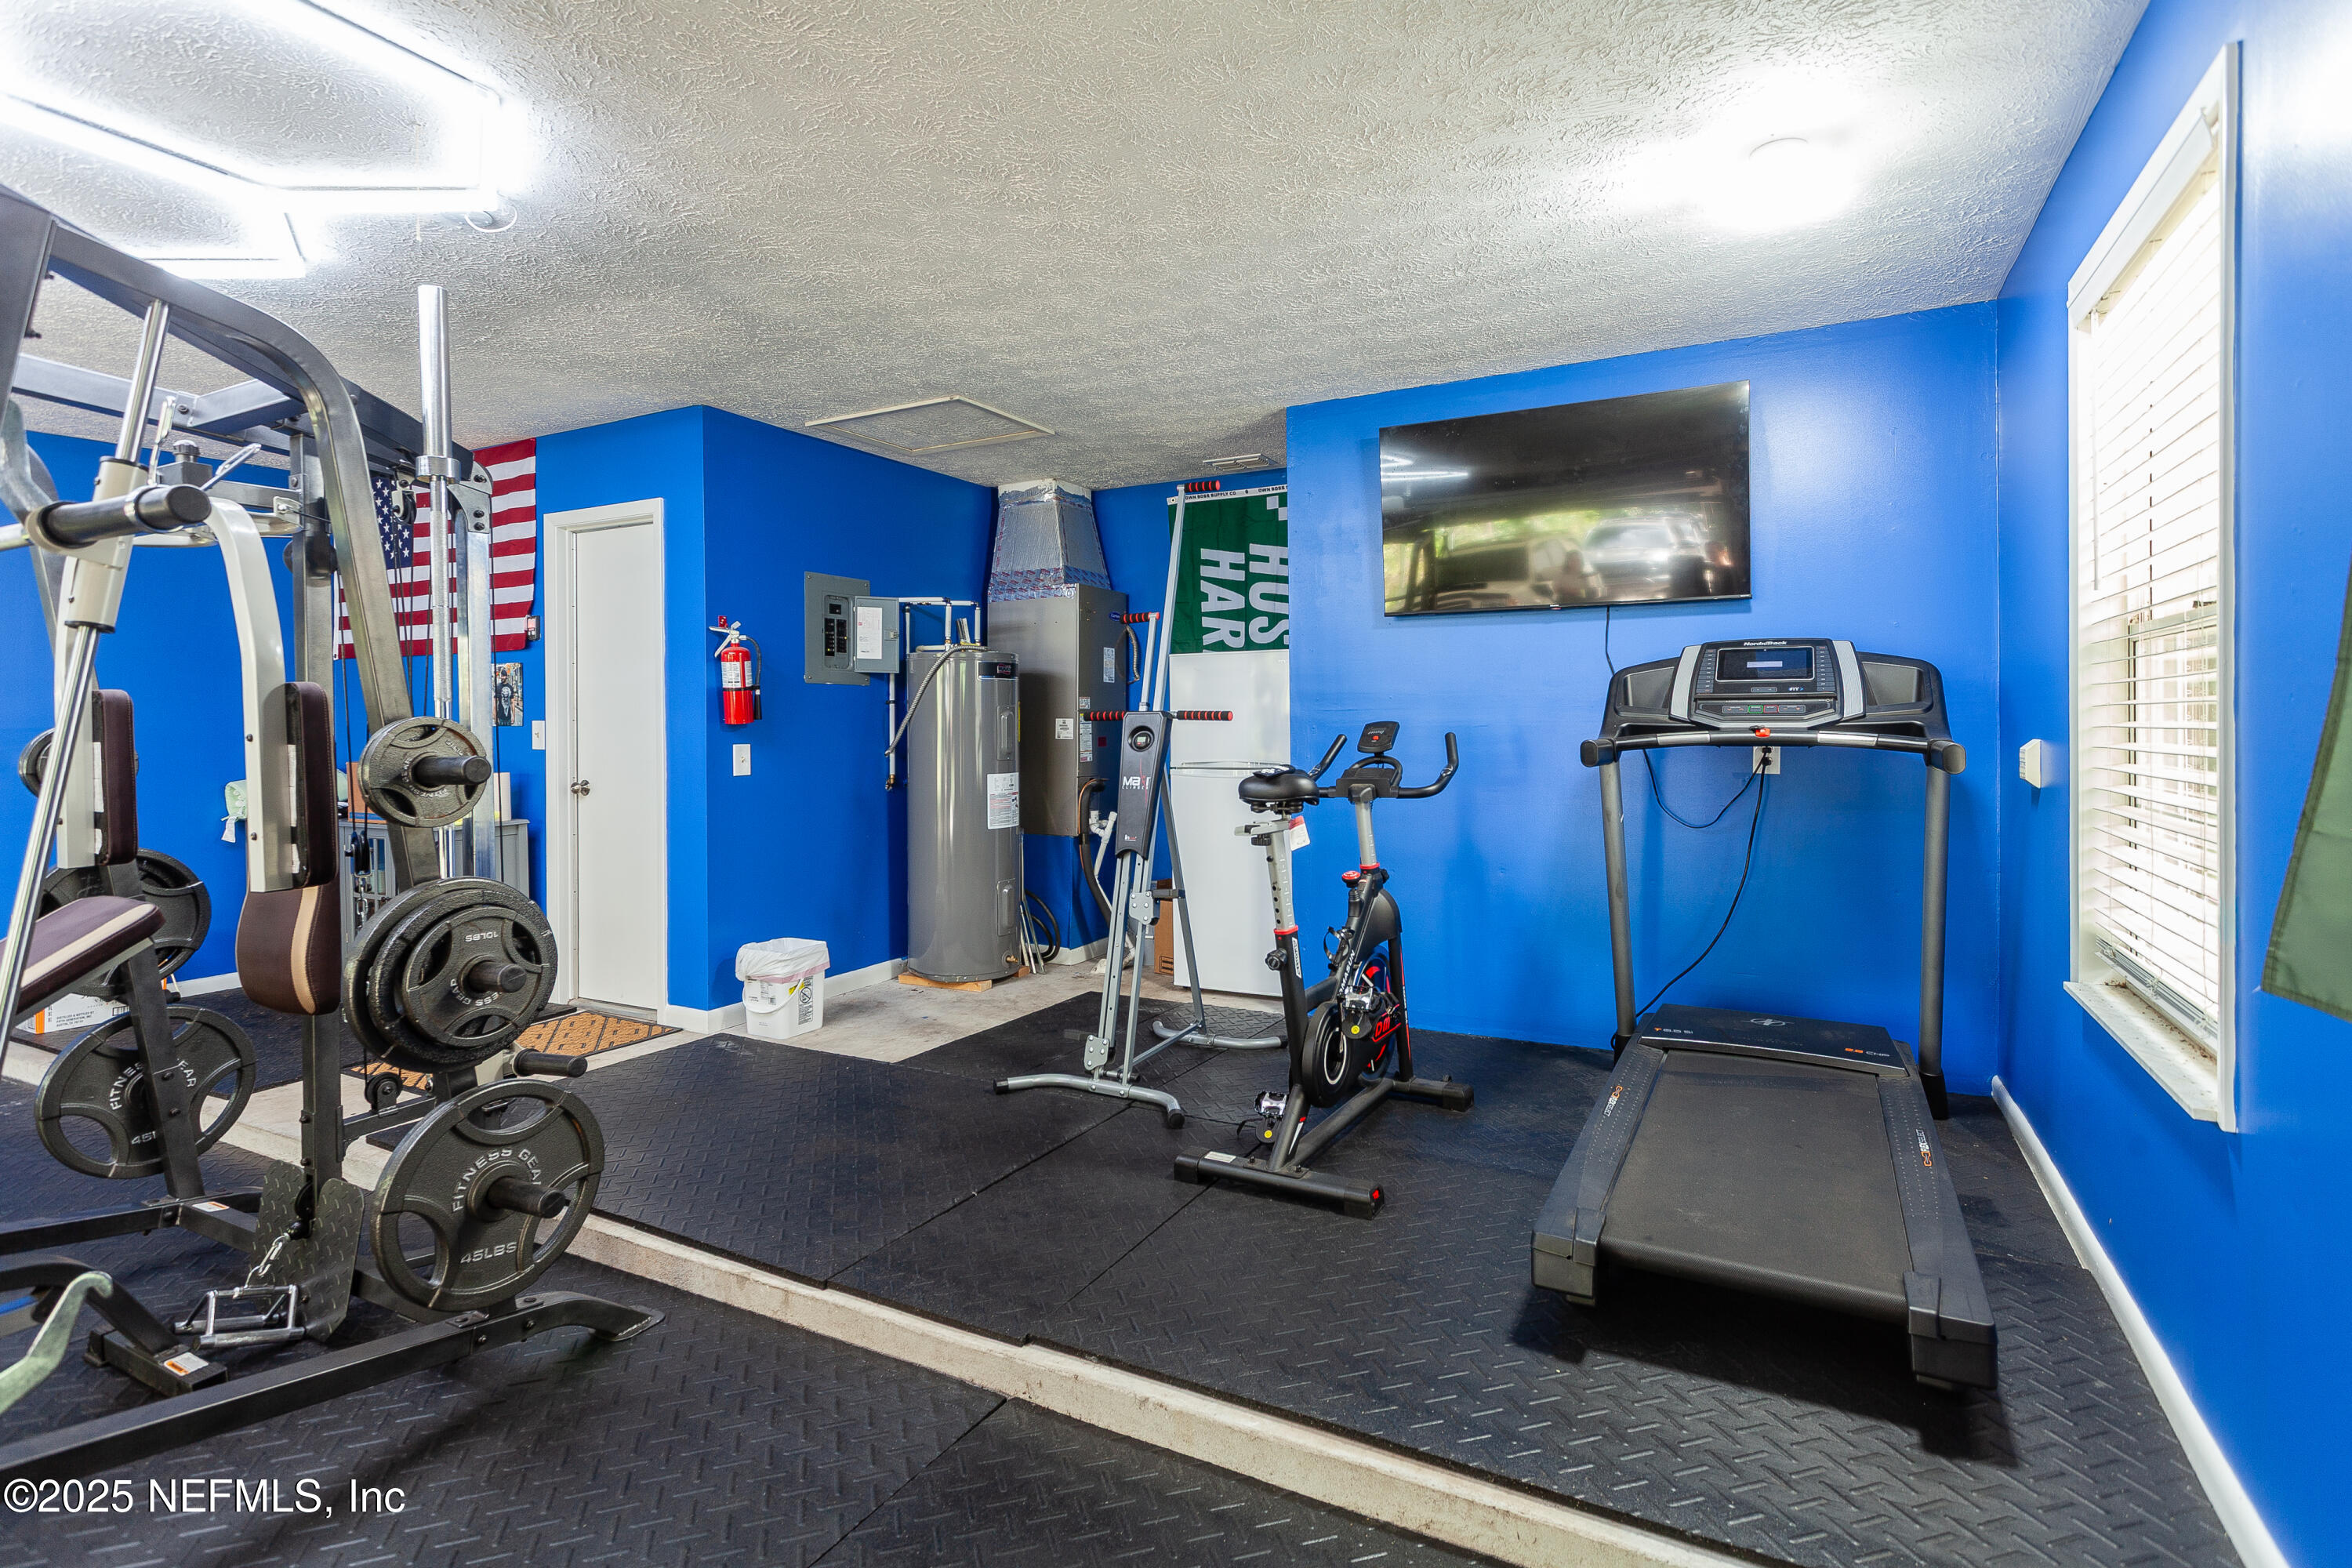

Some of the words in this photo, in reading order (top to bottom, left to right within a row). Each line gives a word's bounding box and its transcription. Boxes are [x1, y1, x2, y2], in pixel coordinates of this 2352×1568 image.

[1200, 548, 1246, 652] HAR
[1249, 543, 1289, 645] HUS
[465, 931, 499, 942] 10LBS
[110, 1062, 143, 1110] FITNES
[176, 1058, 197, 1087] EAR
[451, 1149, 513, 1213] FITNESS
[459, 1241, 517, 1264] 45LBS
